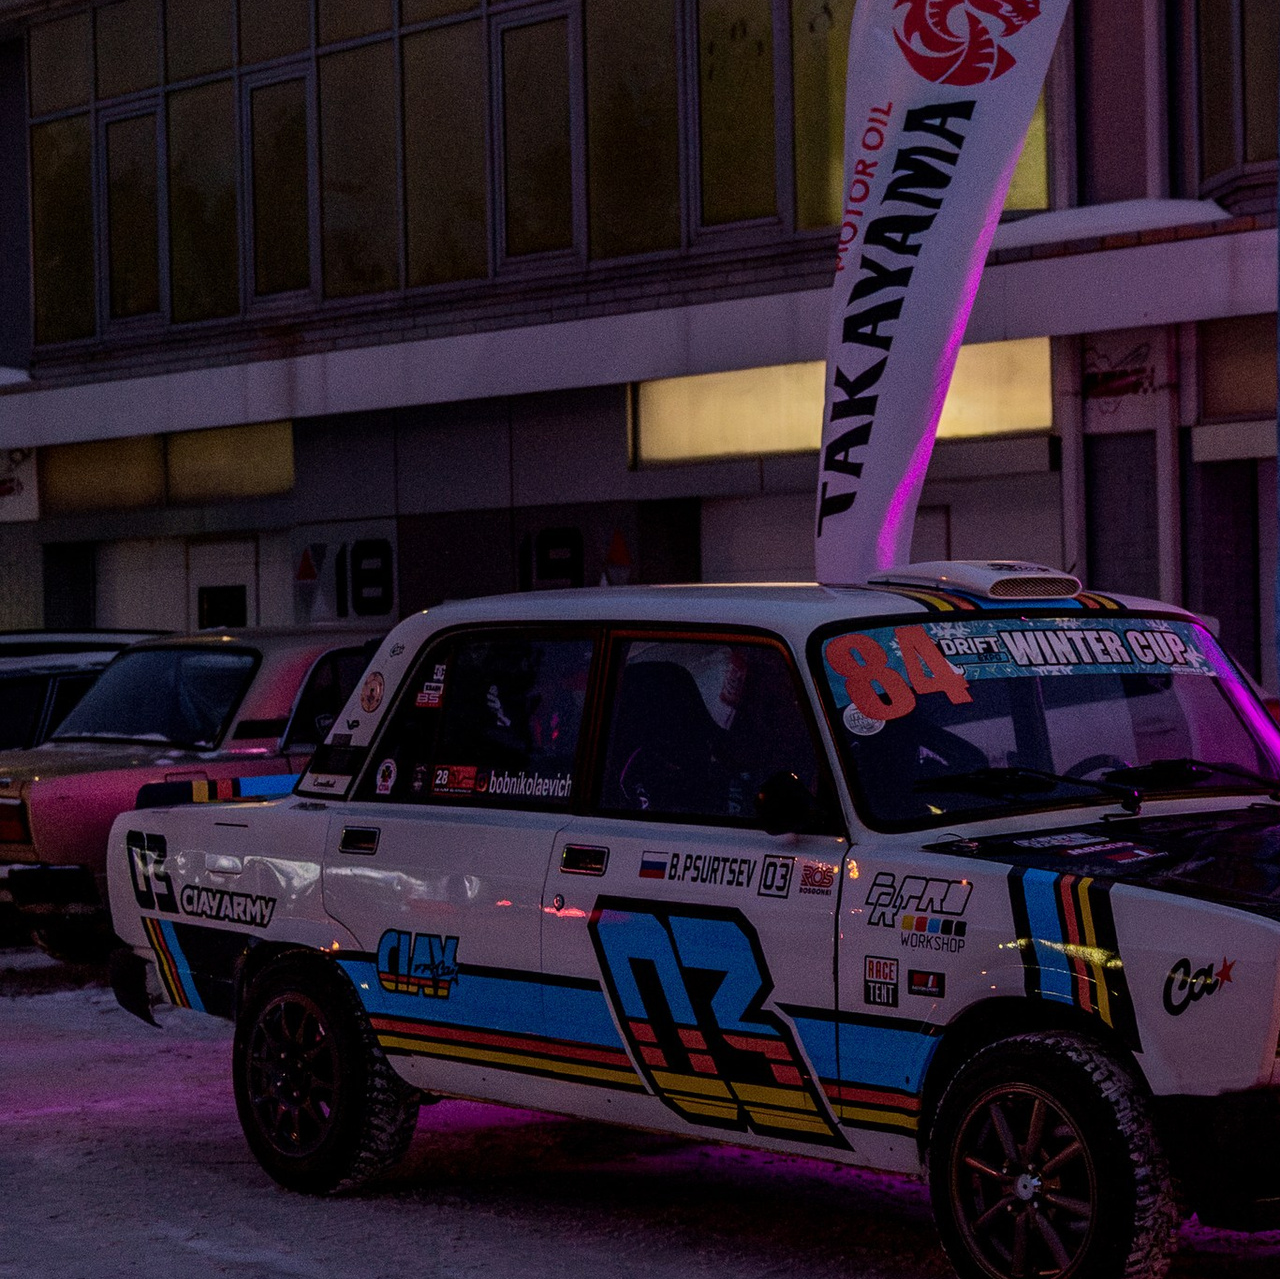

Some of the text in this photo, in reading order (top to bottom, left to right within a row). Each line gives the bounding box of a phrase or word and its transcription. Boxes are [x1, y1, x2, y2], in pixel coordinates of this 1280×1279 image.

[861, 101, 893, 151] OIL
[817, 99, 977, 538] TAKAYAMA
[335, 538, 394, 618] 18
[939, 636, 1000, 656] DRIFT
[1000, 629, 1188, 666] WINTER CUP
[825, 625, 974, 721] 84
[435, 769, 450, 785] 28
[488, 770, 573, 798] bobnikolaevich
[668, 853, 790, 892] B.PSURTSEV 03
[900, 931, 966, 953] WORKSHOP
[867, 959, 895, 981] RACE
[867, 982, 895, 1005] TENT
